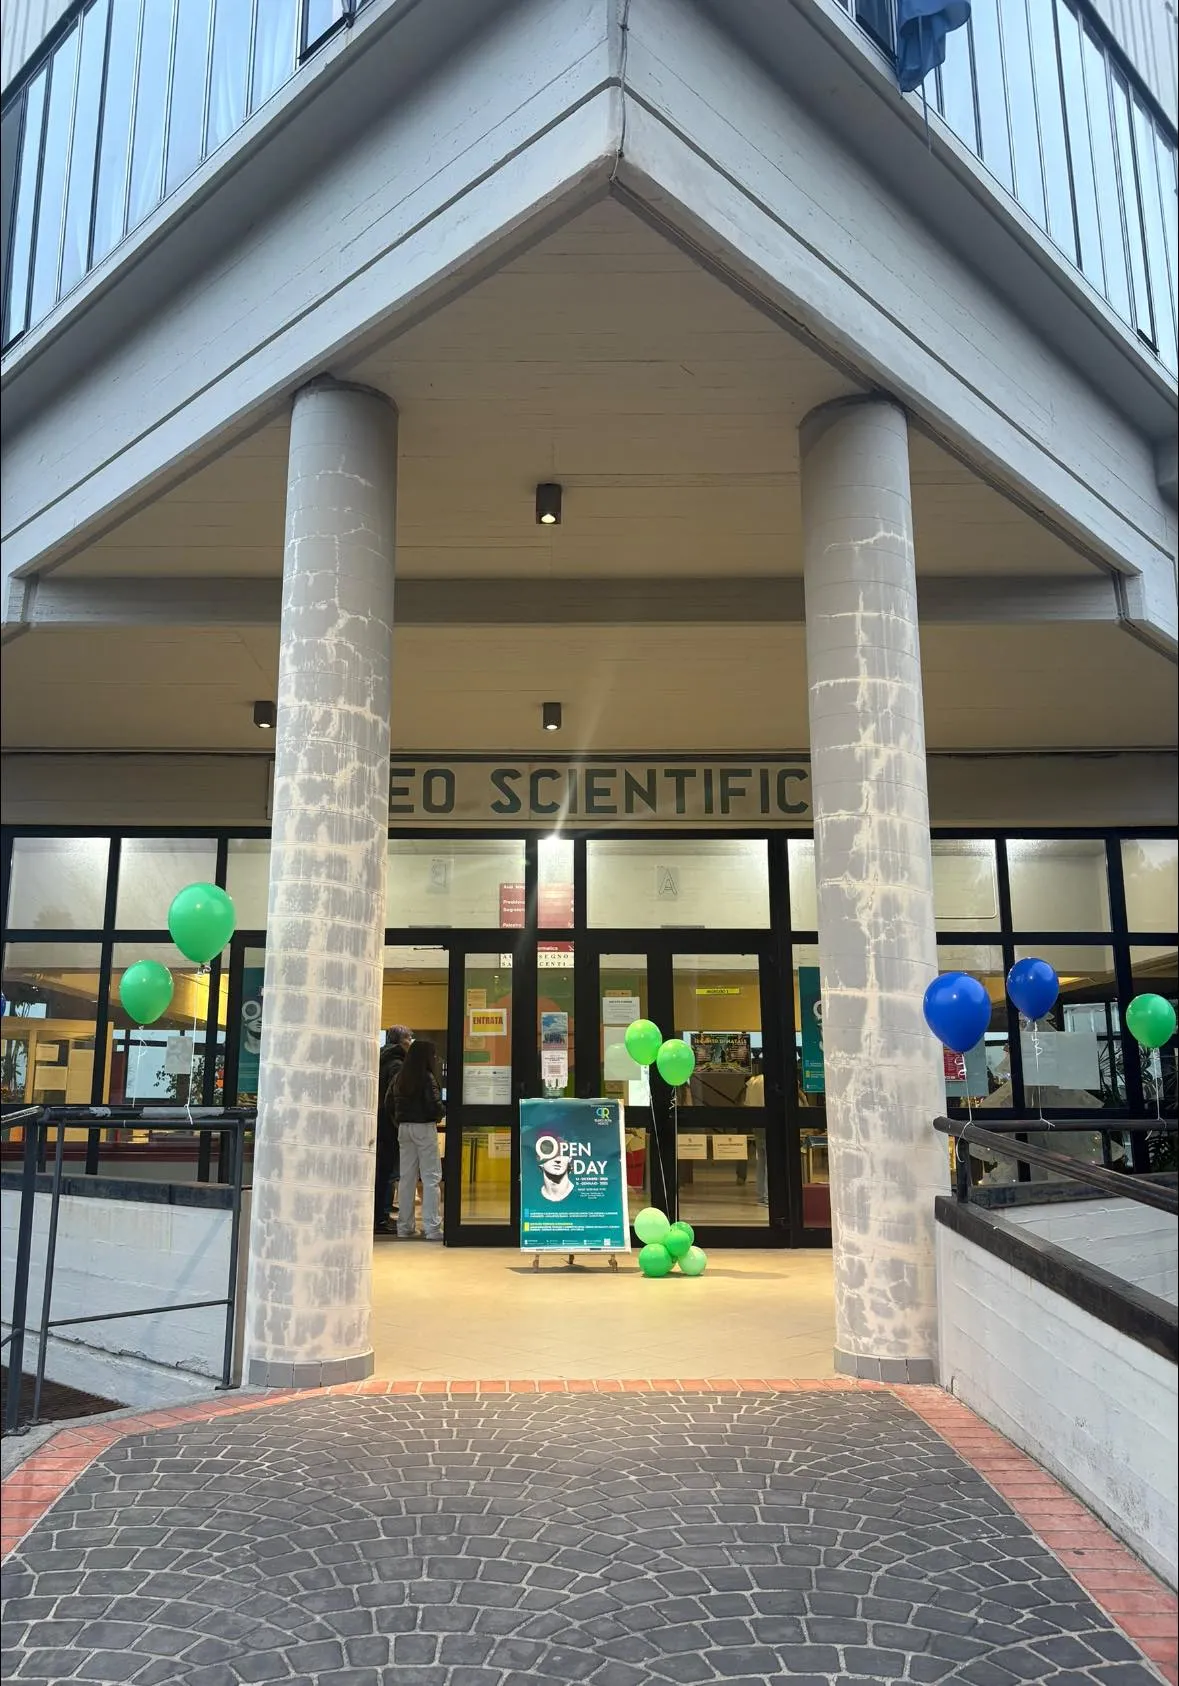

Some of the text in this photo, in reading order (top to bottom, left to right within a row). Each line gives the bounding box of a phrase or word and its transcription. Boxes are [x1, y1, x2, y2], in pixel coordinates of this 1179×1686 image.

[473, 1016, 504, 1025] ENTRATA
[536, 1136, 592, 1161] OPEN
[573, 1160, 608, 1175] DAY
